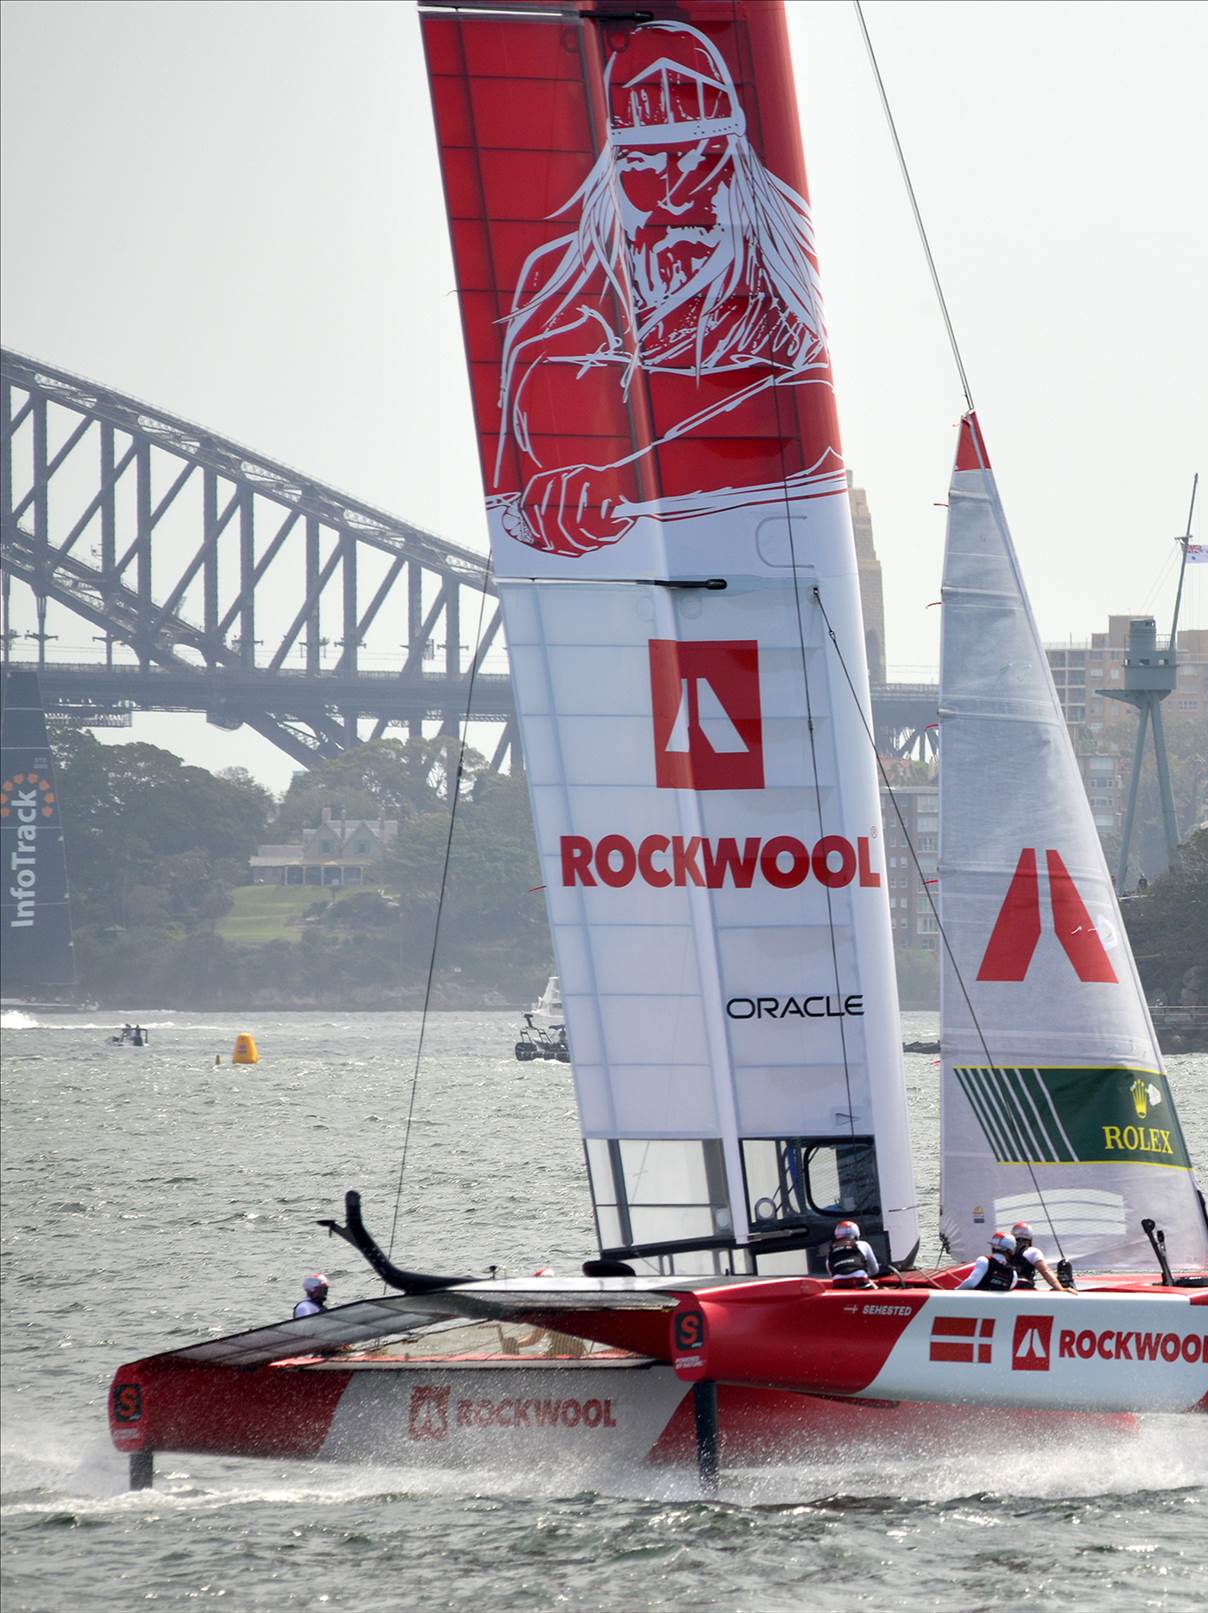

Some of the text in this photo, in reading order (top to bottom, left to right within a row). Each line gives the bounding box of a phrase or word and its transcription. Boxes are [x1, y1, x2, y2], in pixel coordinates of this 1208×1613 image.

[10, 789, 37, 928] InfoTrack
[559, 834, 881, 889] ROCKWOOL
[726, 994, 865, 1019] ORACLE
[1102, 1126, 1174, 1154] ROLEX
[862, 1305, 912, 1316] SEHESTED
[456, 1398, 617, 1428] ROCKWOOL
